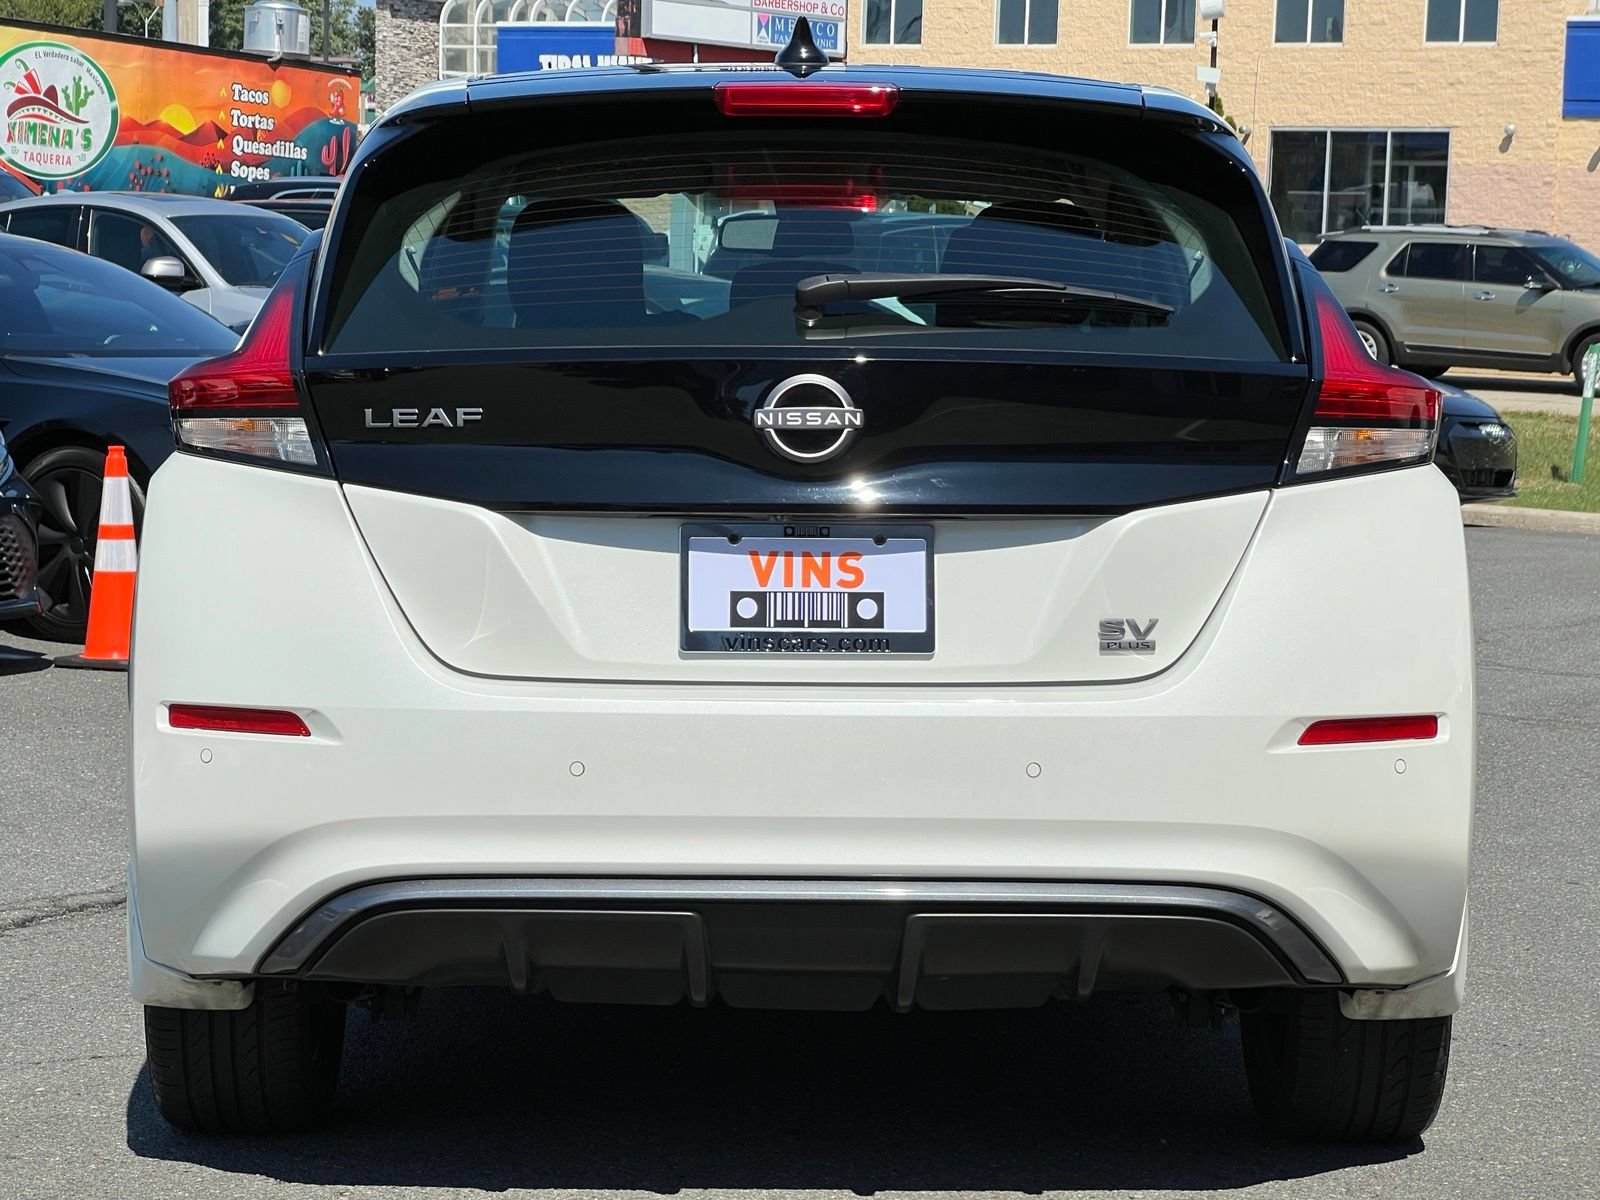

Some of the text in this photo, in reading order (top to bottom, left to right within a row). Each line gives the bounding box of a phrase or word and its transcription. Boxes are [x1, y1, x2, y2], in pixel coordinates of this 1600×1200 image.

[754, 0, 819, 13] BARBERSHOP
[820, 1, 828, 15] &
[774, 17, 835, 37] MEICO
[231, 83, 270, 105] Tacos
[230, 108, 275, 131] Tortas
[6, 120, 93, 152] XIMENA'S
[232, 135, 308, 160] Quesadillas
[23, 151, 72, 167] TAQUERIA
[230, 160, 270, 182] Sopes
[364, 407, 483, 428] LEAF
[757, 412, 861, 426] NISSAN
[747, 550, 865, 589] VINS
[1098, 618, 1159, 641] SV
[724, 633, 891, 652] vinscars.com
[1106, 641, 1151, 649] PLUS
